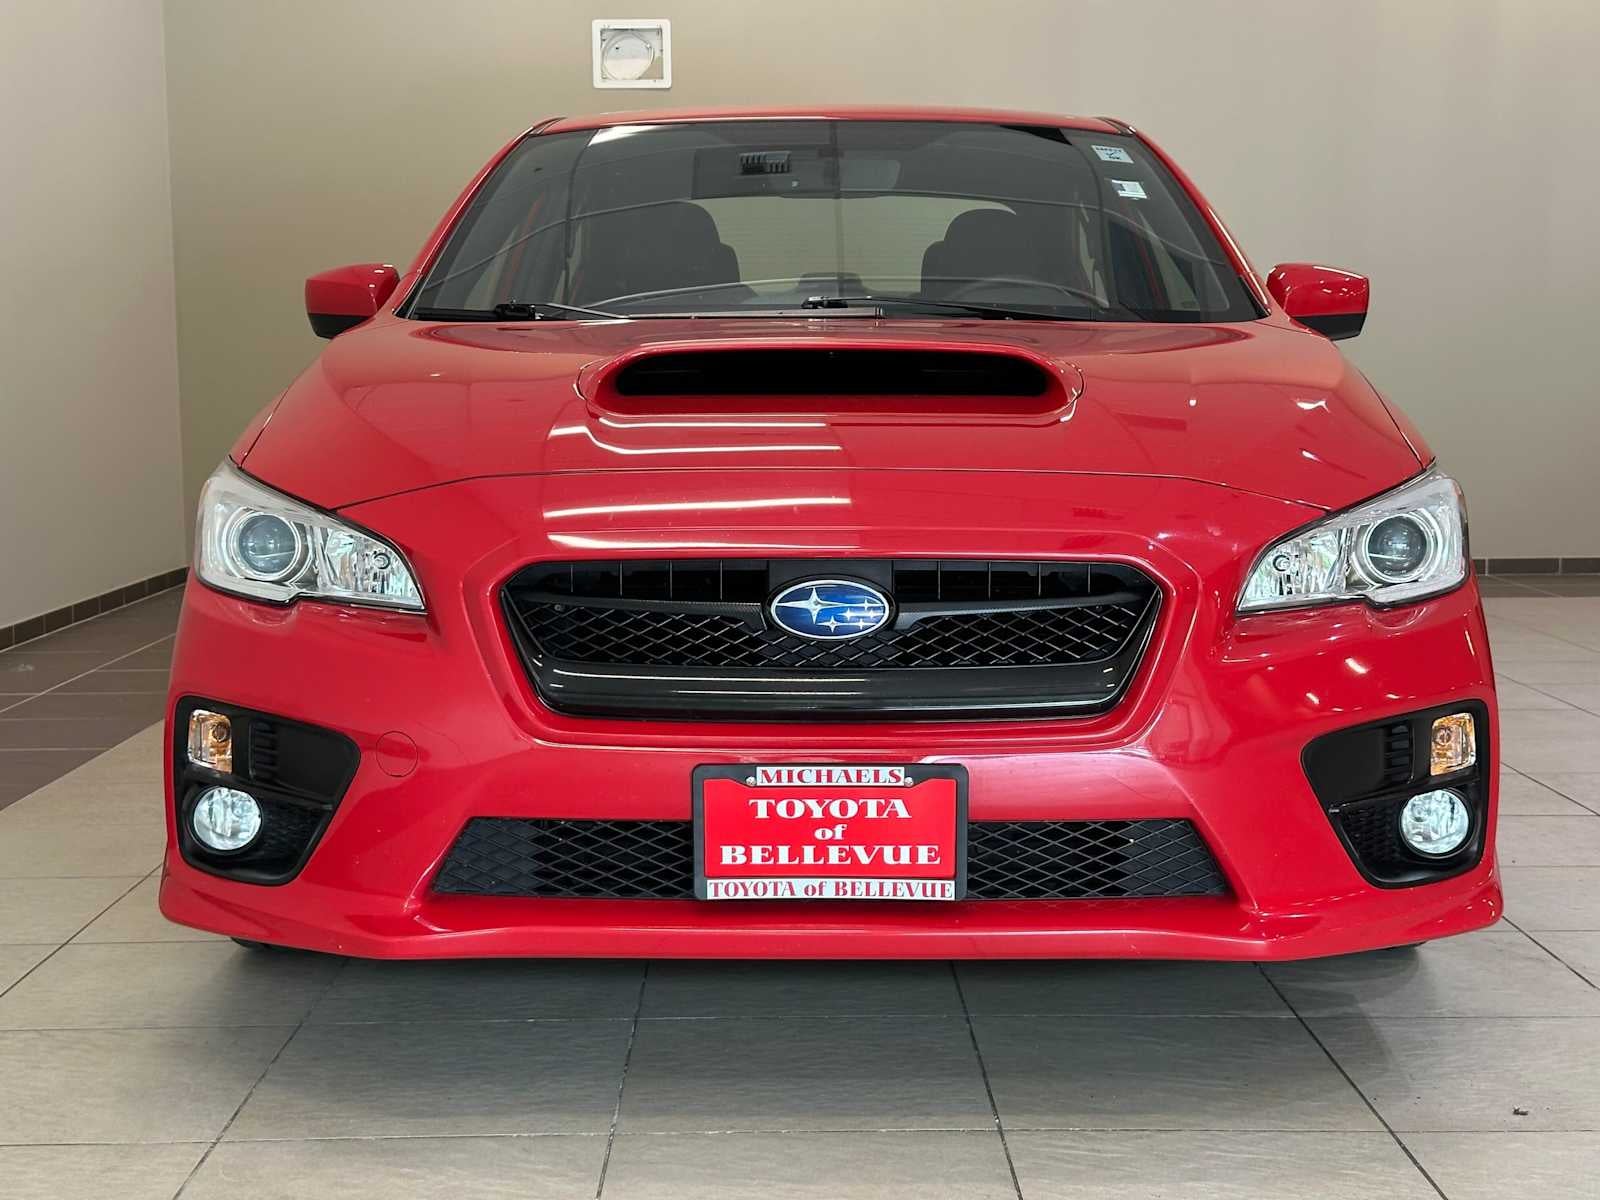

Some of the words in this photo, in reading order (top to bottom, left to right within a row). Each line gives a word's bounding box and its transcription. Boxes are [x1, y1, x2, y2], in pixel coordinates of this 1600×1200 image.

[759, 769, 903, 784] MICHAELS
[748, 798, 912, 819] TOYOTA
[814, 824, 848, 841] of
[719, 845, 941, 865] BELLEVUE
[709, 881, 796, 898] TOYOTA
[804, 880, 828, 897] of
[833, 881, 953, 898] BELLEVUE
